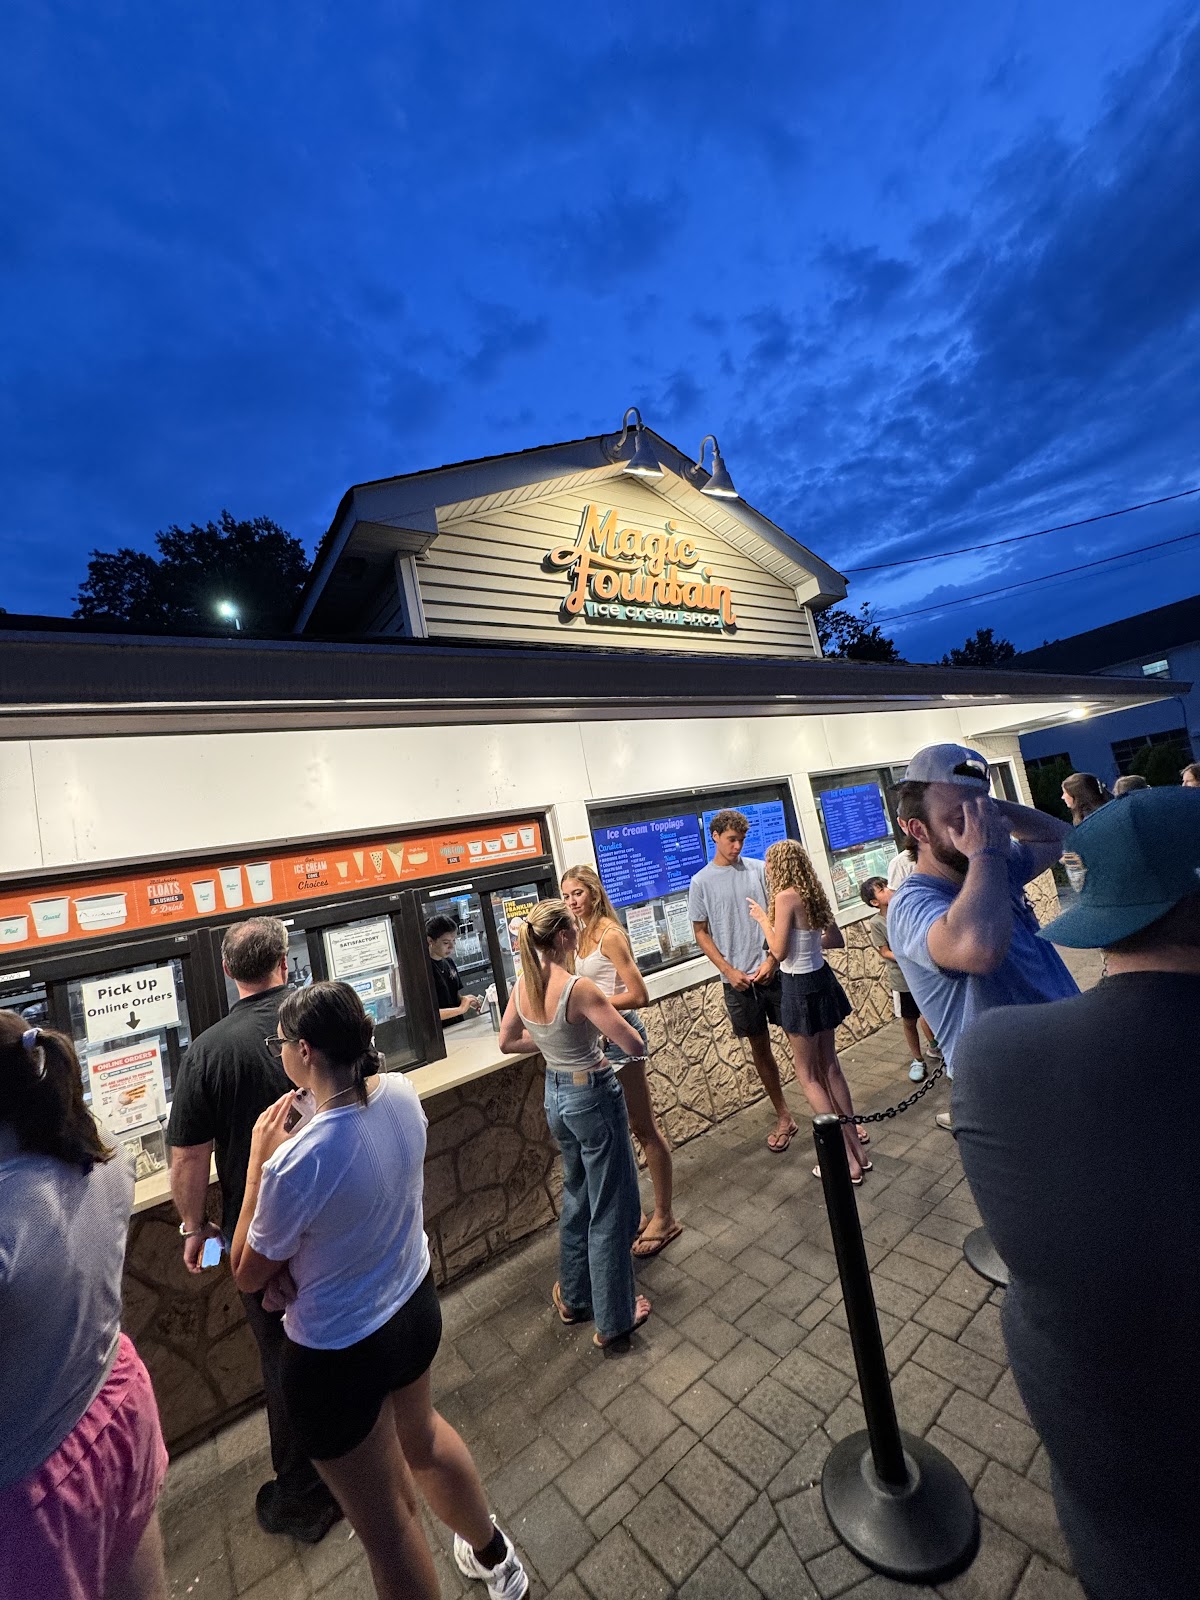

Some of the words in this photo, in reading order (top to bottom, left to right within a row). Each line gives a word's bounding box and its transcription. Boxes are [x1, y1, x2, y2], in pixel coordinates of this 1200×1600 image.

[575, 503, 700, 576] Magic
[549, 545, 737, 625] Fountain
[607, 829, 620, 840] Ice
[622, 825, 648, 837] Cream
[650, 818, 684, 833] Toppings
[598, 841, 623, 852] Candies
[294, 864, 305, 874] ICE
[306, 861, 327, 873] CREAM
[147, 881, 183, 898] FLOATS,
[298, 879, 329, 890] Choices
[153, 895, 179, 904] SLUSHIES
[151, 907, 158, 915] &
[160, 901, 184, 913] Drink
[506, 902, 533, 913] FRANKLIN
[42, 913, 61, 921] Quart
[340, 935, 380, 948] SATISFACTORY
[97, 983, 133, 1000] Pick
[137, 978, 158, 993] Up
[87, 1000, 129, 1018] Online
[132, 991, 173, 1007] Orders
[97, 1059, 124, 1071] ONLINE
[124, 1051, 153, 1063] ORDERS
